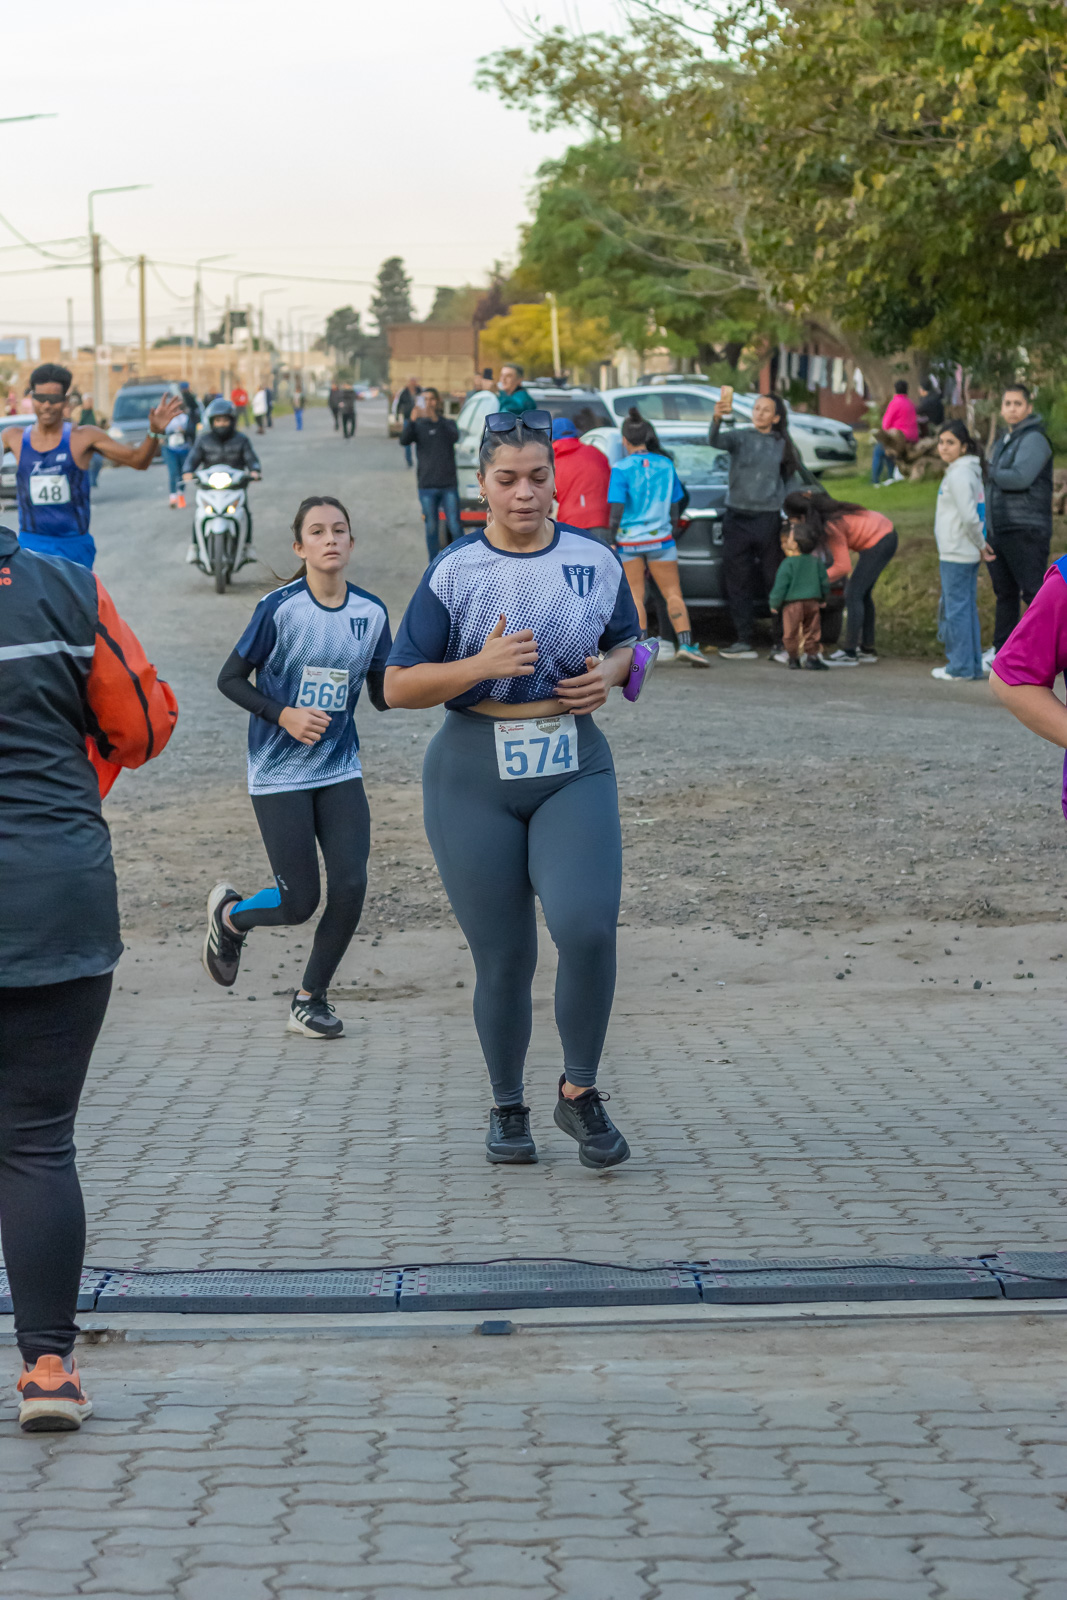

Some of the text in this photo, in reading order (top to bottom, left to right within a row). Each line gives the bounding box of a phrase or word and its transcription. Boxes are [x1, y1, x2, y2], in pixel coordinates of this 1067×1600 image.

[38, 485, 62, 502] 48
[568, 567, 590, 575] SFC
[300, 681, 348, 709] 569
[504, 734, 573, 776] 574
